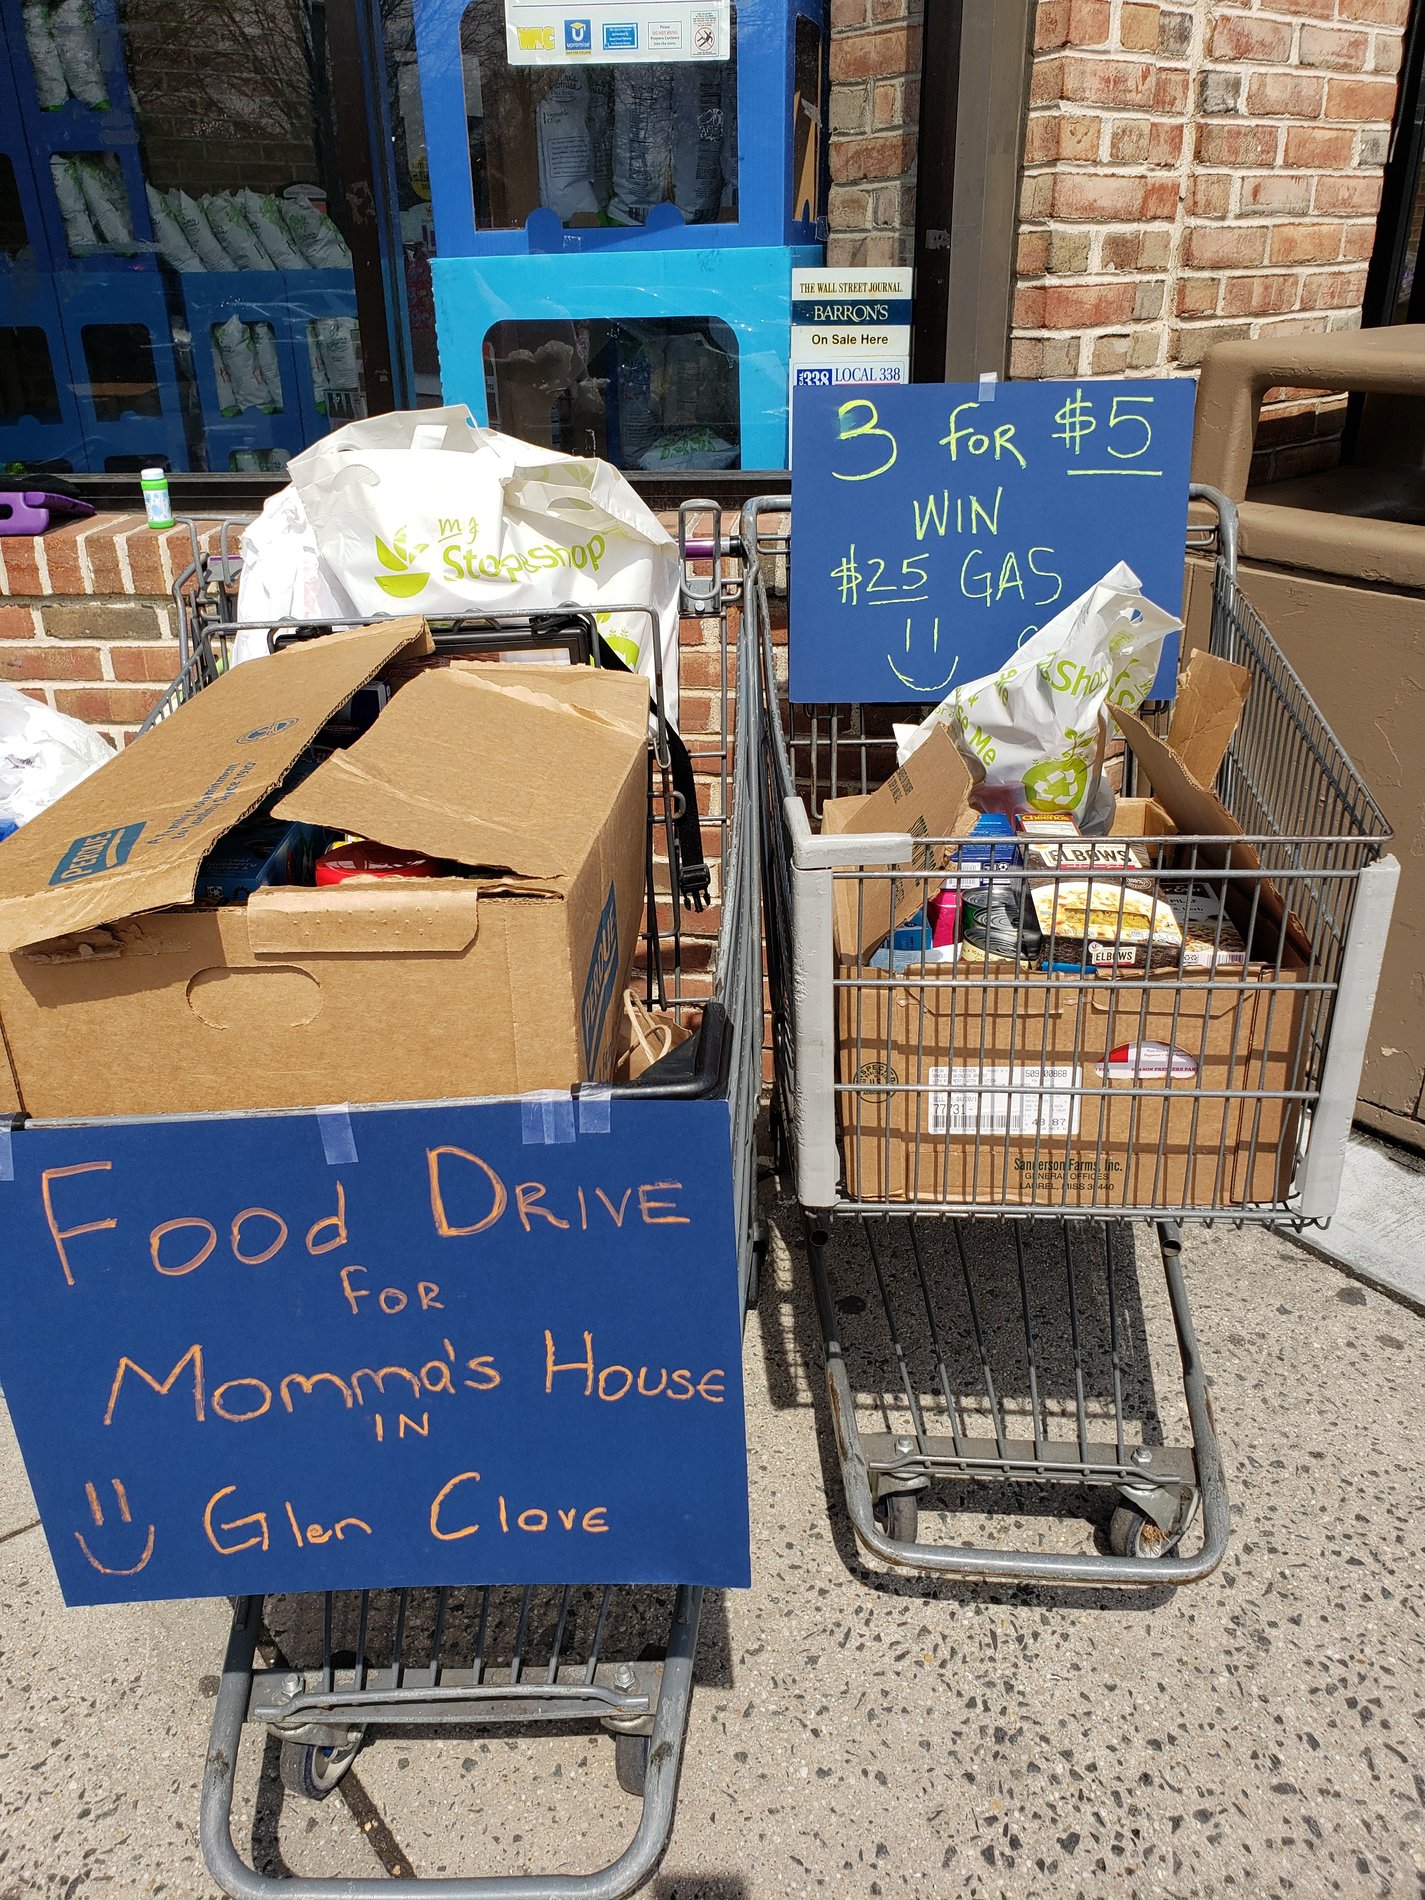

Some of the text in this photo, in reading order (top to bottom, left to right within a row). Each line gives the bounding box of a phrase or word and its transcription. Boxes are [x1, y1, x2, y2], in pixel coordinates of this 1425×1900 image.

[800, 282, 815, 293] THE
[817, 282, 837, 293] WALL
[838, 282, 867, 293] STREET
[813, 304, 889, 322] BARRON'S
[811, 333, 889, 345] On Sale Here
[835, 367, 900, 382] LOCAL 338
[832, 399, 898, 481] 3
[1051, 388, 1155, 460] $5
[912, 486, 1003, 541] WIN
[830, 544, 1063, 607] $25 GAS
[1021, 813, 1070, 821] Cheerios
[61, 831, 113, 881] PERDUE
[1096, 951, 1133, 961] ELBWS
[1025, 1069, 1068, 1078] 50900868
[1104, 1158, 1123, 1172] Inc.
[1087, 1183, 1115, 1191] 3440
[41, 1145, 693, 1286] Food DRIVE
[340, 1265, 445, 1315] FOR
[104, 1337, 501, 1426] Momma's
[375, 1412, 430, 1442] IN
[203, 1485, 373, 1555] Glen
